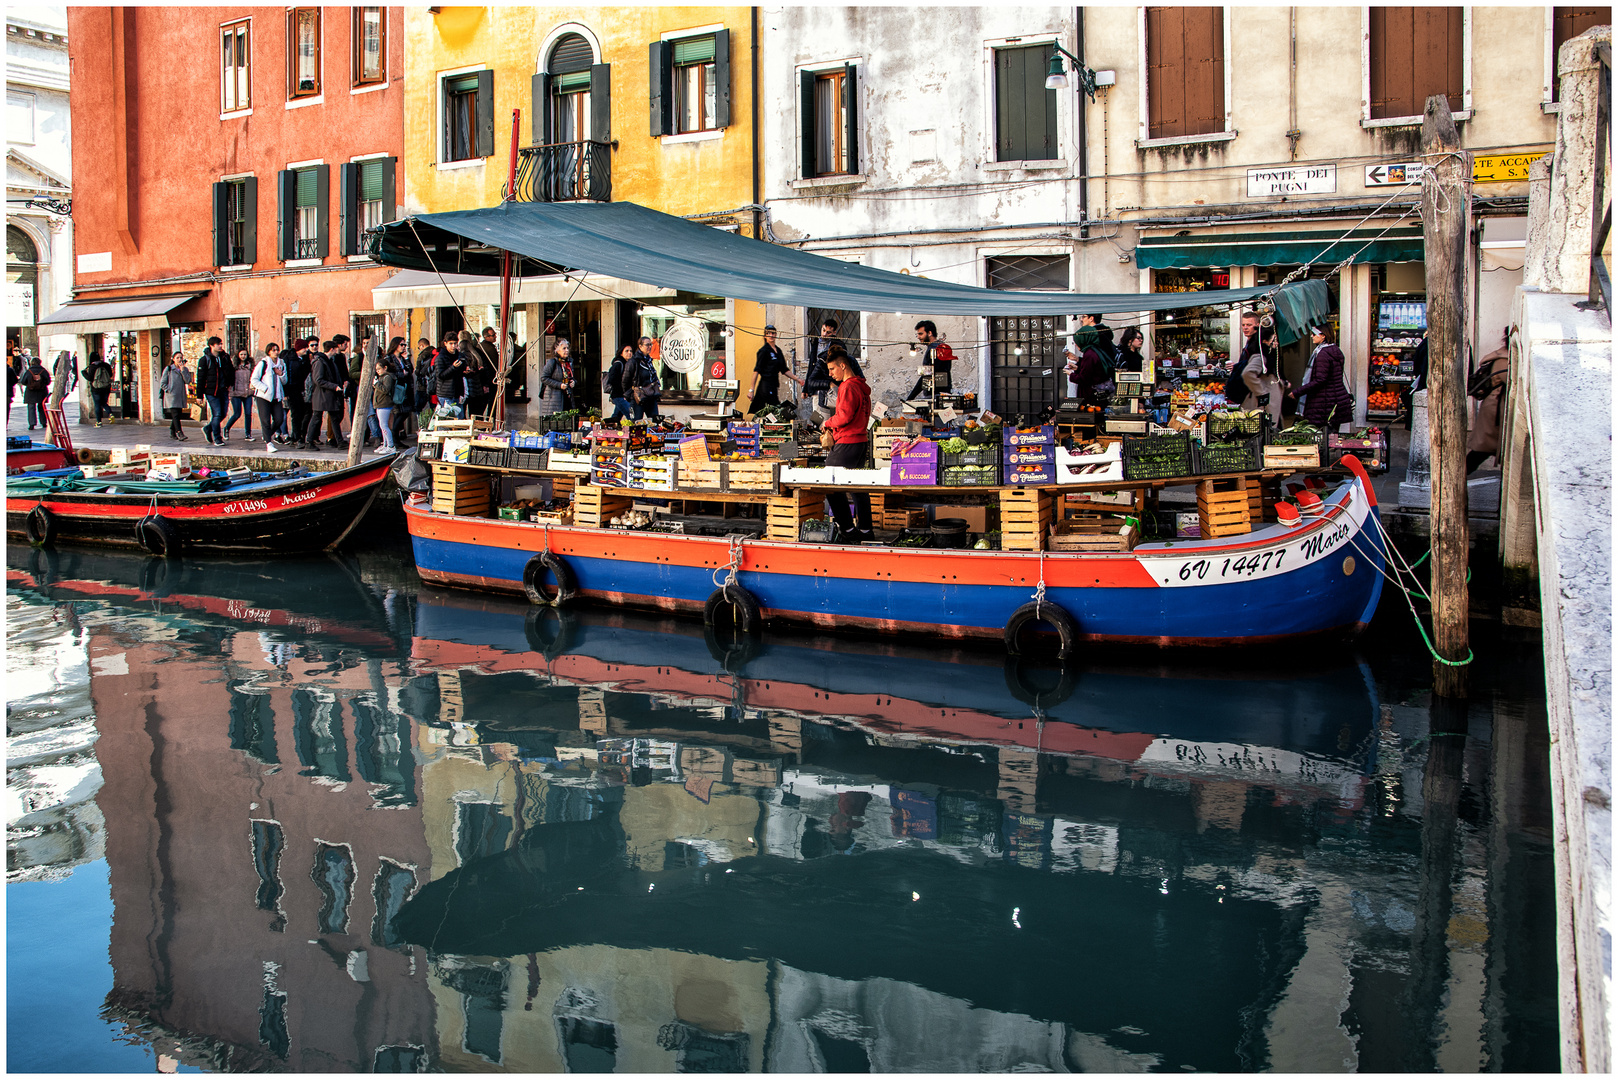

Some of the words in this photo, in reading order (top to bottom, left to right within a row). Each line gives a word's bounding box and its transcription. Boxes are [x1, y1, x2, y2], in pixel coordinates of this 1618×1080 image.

[1473, 160, 1493, 168] .TE
[1255, 171, 1296, 181] PONTE
[1307, 169, 1328, 179] DEI
[1508, 168, 1518, 177] S.
[1271, 182, 1307, 192] PUGNI
[1217, 274, 1230, 286] 10
[673, 348, 696, 361] SUGO
[712, 364, 725, 376] 6€
[281, 491, 317, 506] Mario
[1221, 549, 1287, 577] 14477
[1300, 523, 1350, 560] Mario
